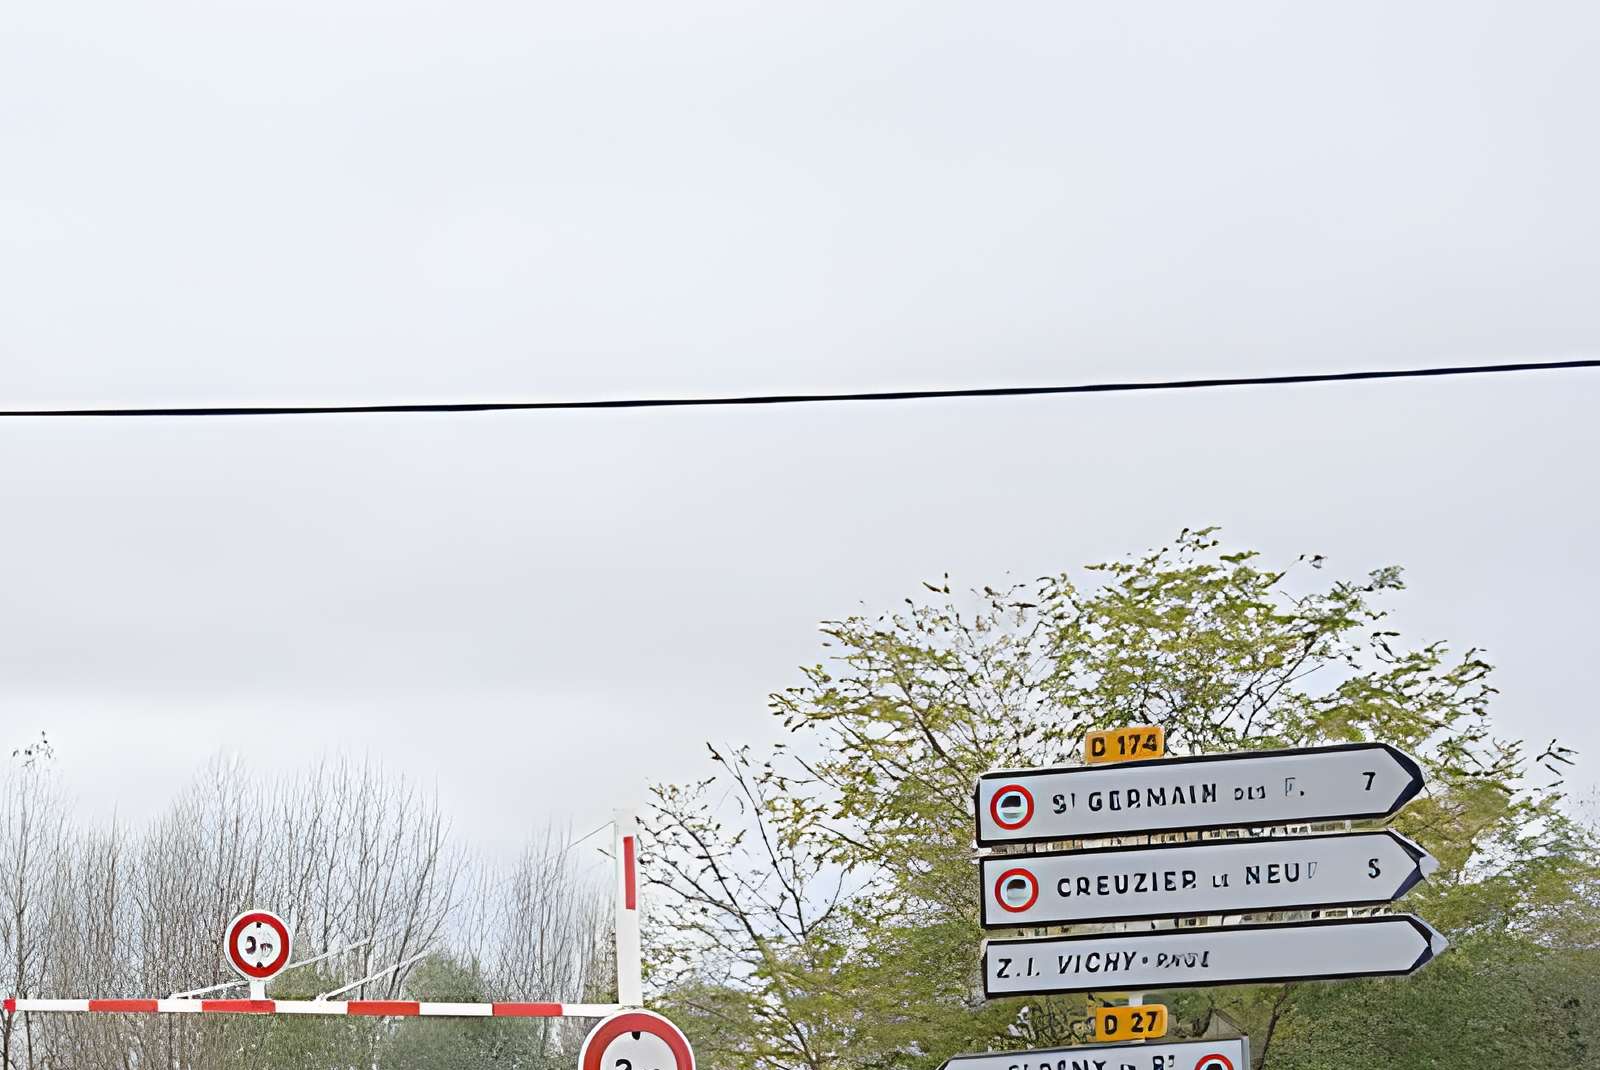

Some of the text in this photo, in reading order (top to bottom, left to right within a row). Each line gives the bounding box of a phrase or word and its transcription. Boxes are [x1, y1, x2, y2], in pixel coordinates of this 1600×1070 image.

[1090, 733, 1159, 758] D 174
[1087, 782, 1218, 812] GERMAIN
[1361, 771, 1377, 792] 7
[1056, 869, 1197, 899] CREUZIER
[1104, 1010, 1159, 1036] D 27
